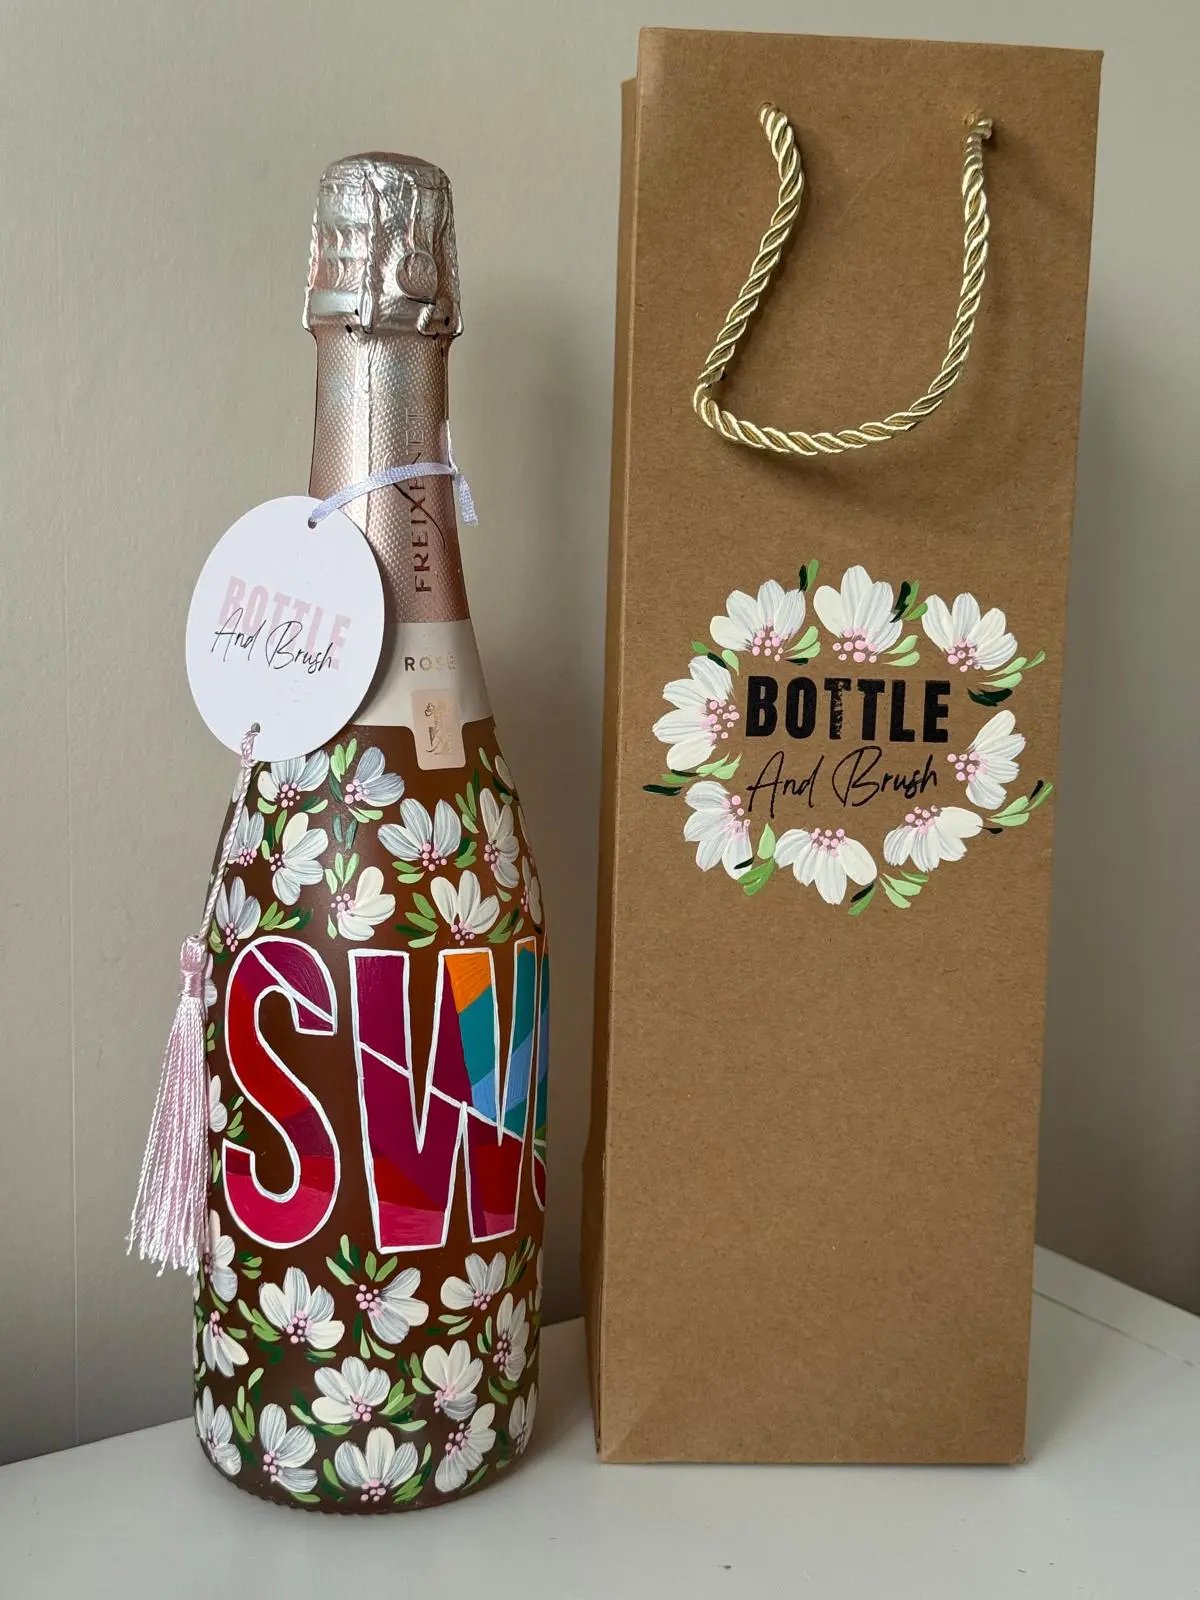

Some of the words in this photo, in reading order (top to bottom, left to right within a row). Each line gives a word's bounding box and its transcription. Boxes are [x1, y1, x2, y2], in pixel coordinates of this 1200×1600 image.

[211, 607, 267, 662] And
[265, 620, 334, 674] Brush
[217, 575, 352, 671] BOTTLE
[745, 675, 952, 743] BOTTLE
[746, 750, 825, 819] And
[831, 745, 938, 807] Brush
